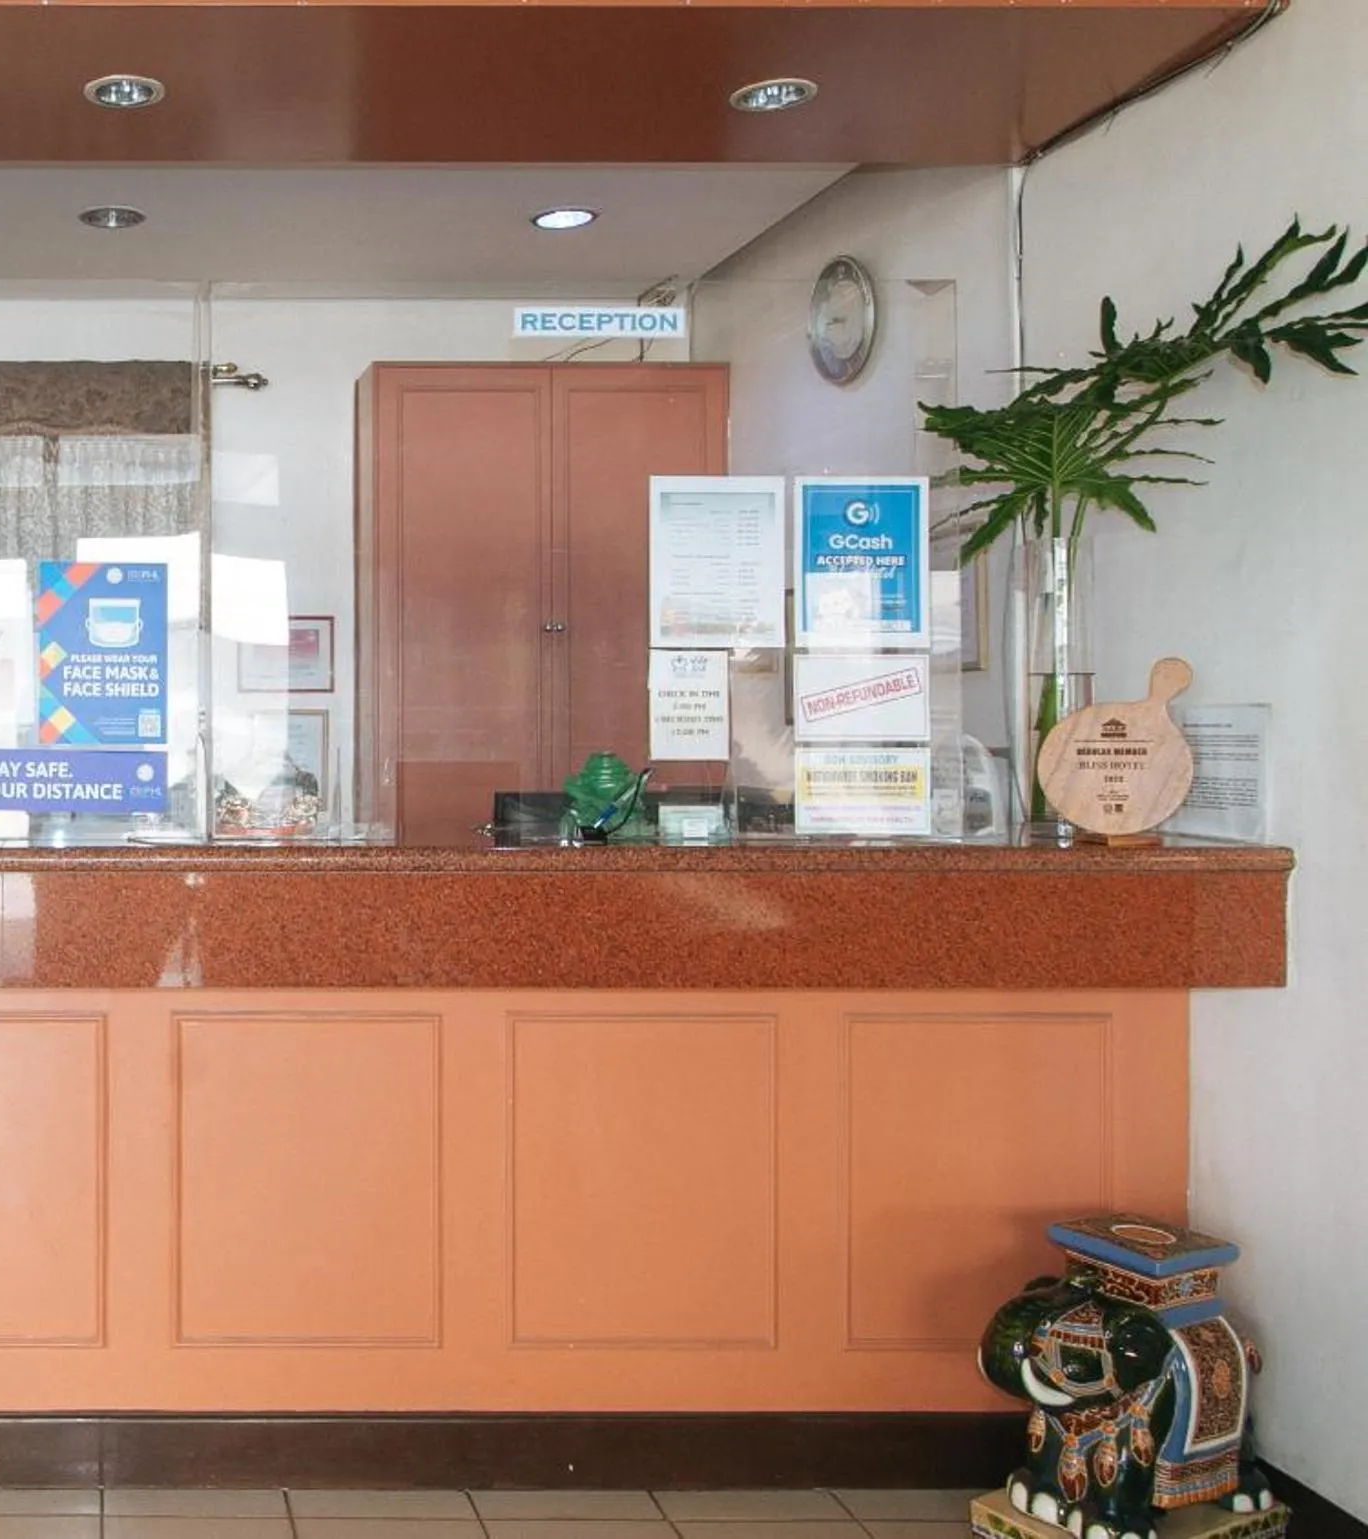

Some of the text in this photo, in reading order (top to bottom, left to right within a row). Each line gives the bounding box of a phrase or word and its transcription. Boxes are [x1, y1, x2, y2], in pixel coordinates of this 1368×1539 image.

[521, 312, 678, 331] RECEPTION
[829, 534, 893, 550] GCash
[816, 555, 905, 566] ACCEPTED HERE
[70, 654, 158, 663] PLEASE WEAR YOUR
[63, 665, 102, 680] FACE
[63, 682, 159, 697] FACE SHIELD
[807, 674, 917, 715] NON-REFUNDABLE
[1076, 747, 1148, 756] REGULAR MEMBER
[26, 761, 73, 778] SAFE.
[1079, 761, 1145, 770] BLISS HOTEL
[900, 770, 918, 783] BAN
[32, 783, 123, 800] DISTANCE
